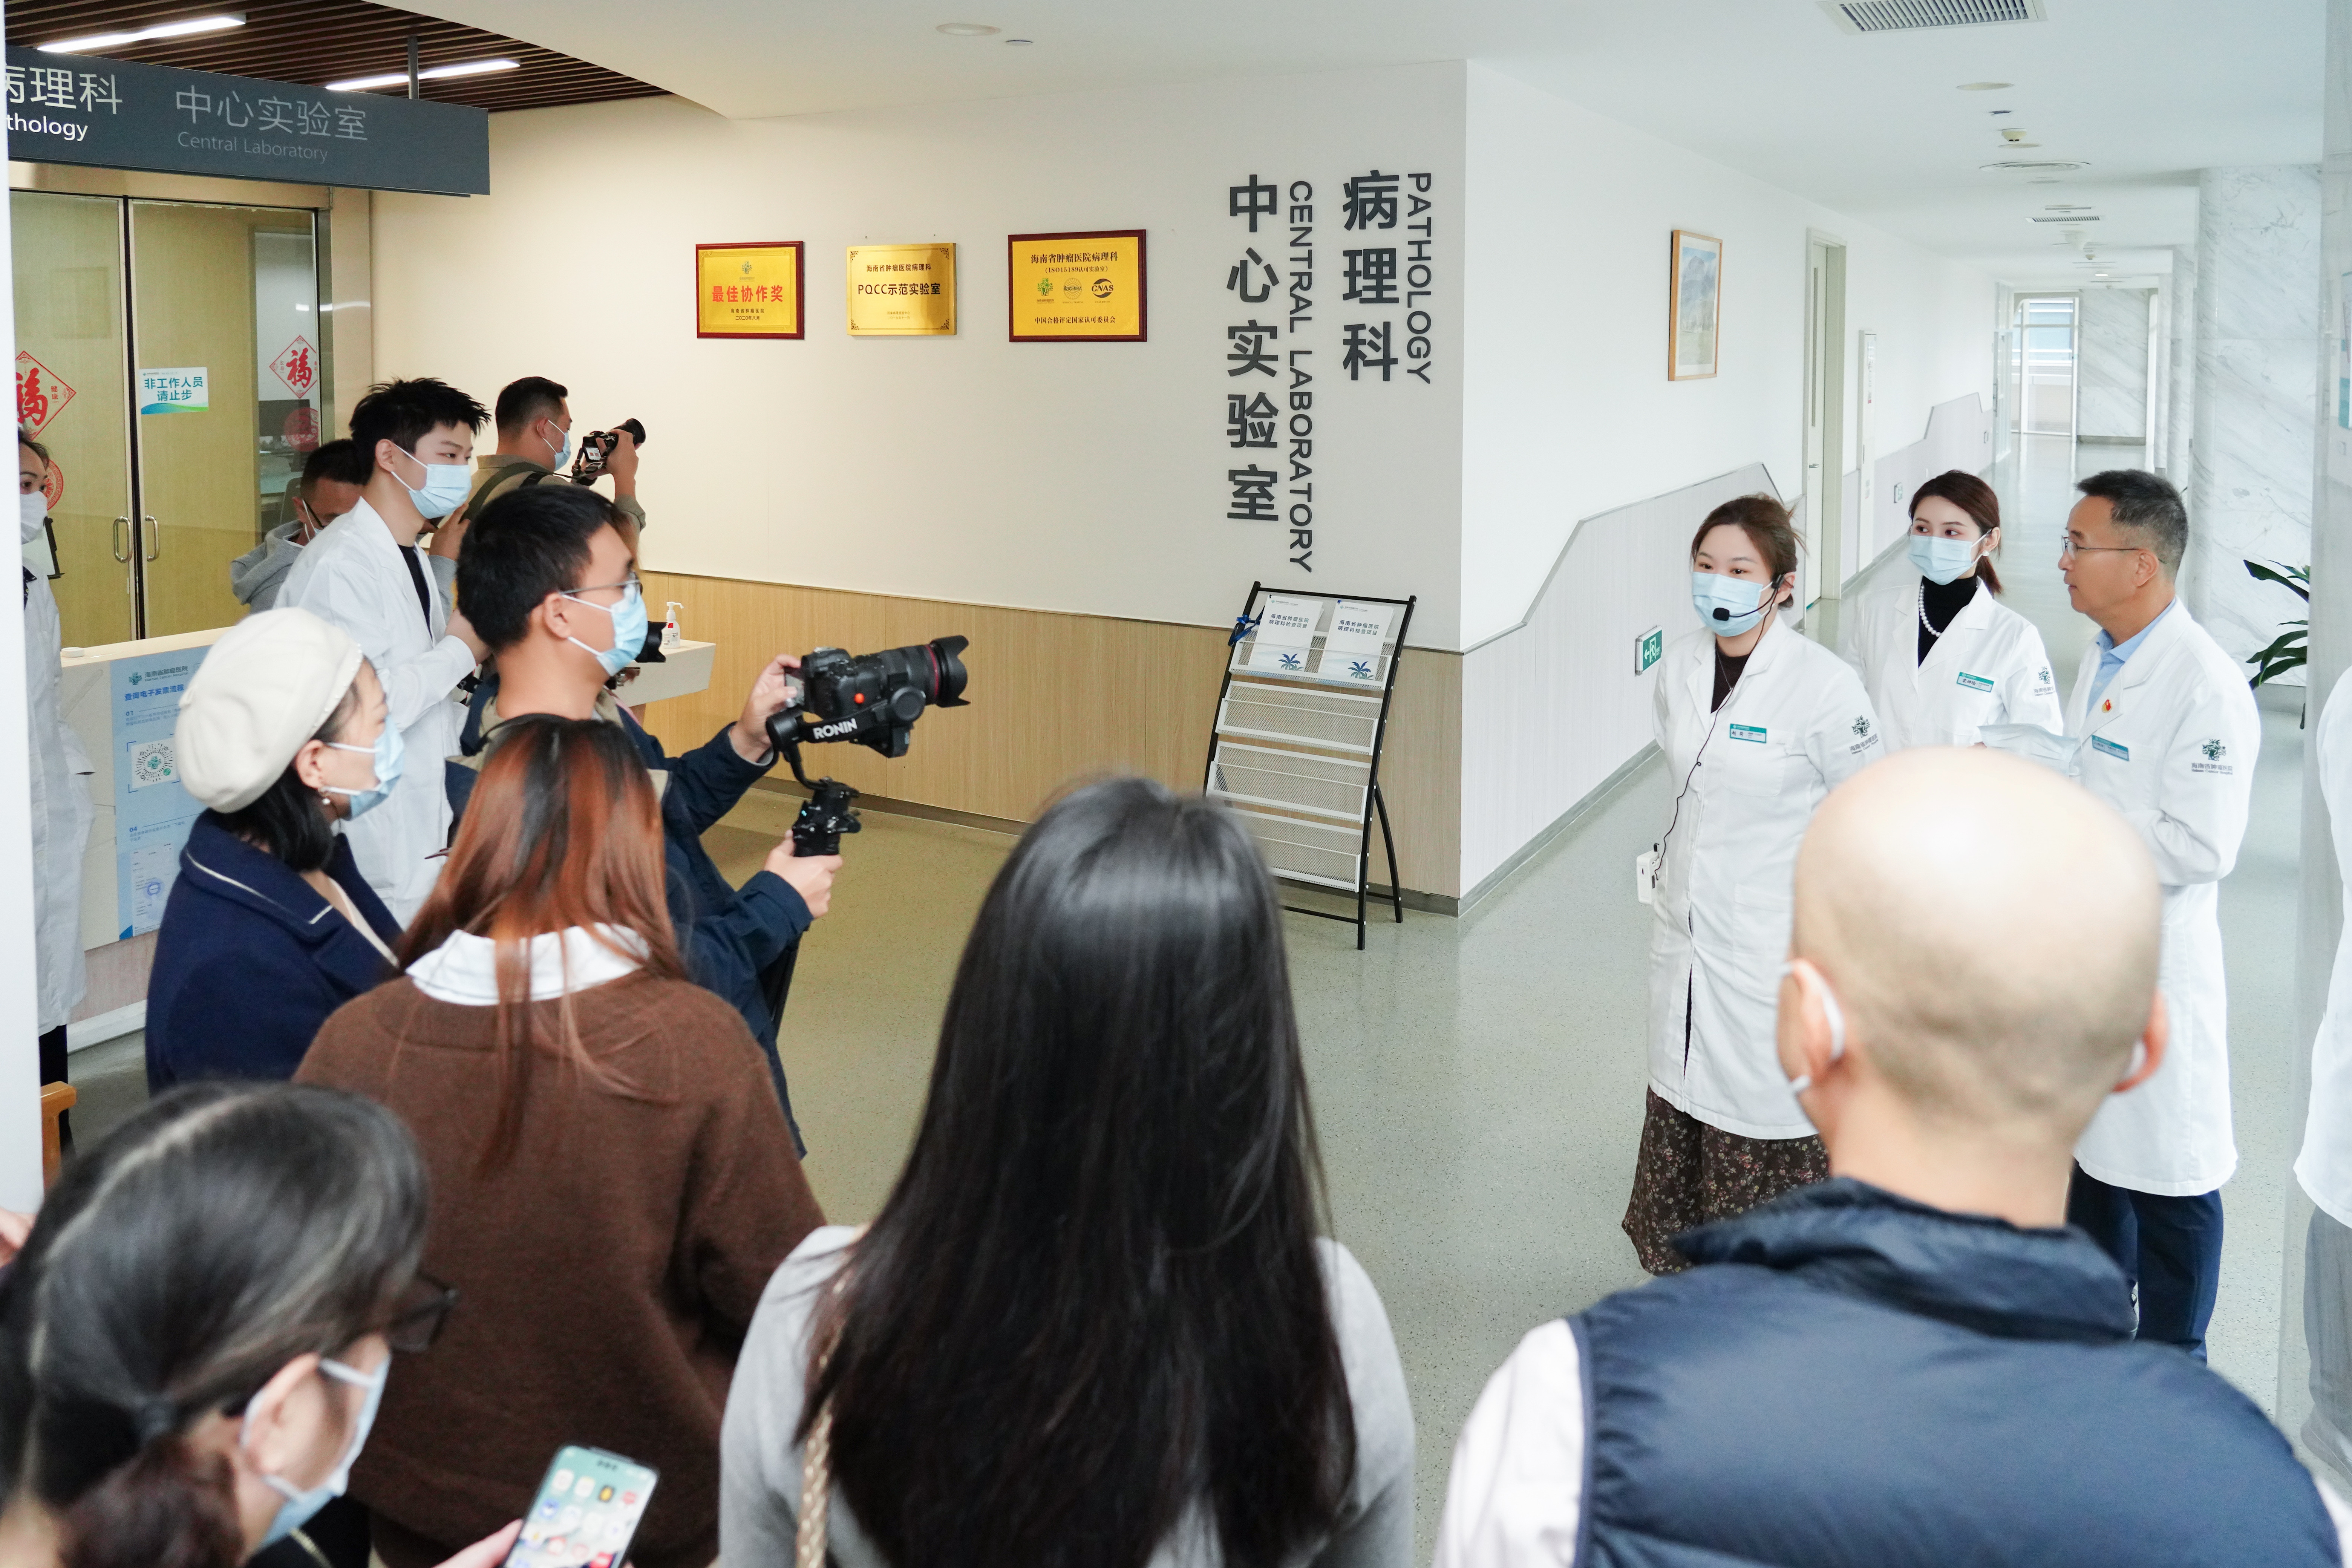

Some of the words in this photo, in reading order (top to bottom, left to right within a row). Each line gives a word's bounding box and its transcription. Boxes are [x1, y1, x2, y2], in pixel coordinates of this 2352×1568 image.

[176, 85, 368, 140] 中心实验室
[178, 131, 237, 152] Central
[244, 138, 328, 164] Laboratory
[1031, 251, 1118, 264] 海南省肿瘤医院病理科
[1289, 181, 1312, 333] CENTRAL
[866, 263, 932, 272] 海南省肿瘤医院病理科
[1342, 170, 1400, 381] 病理科
[1407, 173, 1432, 384] PATHOLOGY
[712, 285, 783, 302] 最佳协作奖
[858, 283, 941, 295] PQCC示范实验室
[1035, 316, 1116, 324] 中国合格评定国家认可委员会
[1227, 174, 1279, 521] 中心实验室
[286, 348, 312, 388] 福
[144, 377, 203, 389] 非工作人员
[157, 389, 192, 401] 请止步
[1289, 350, 1312, 573] LABORATORY
[1269, 619, 1308, 629] 病理科检查项目
[1271, 614, 1309, 623] 海南省肿瘤医院
[1339, 620, 1379, 629] 海南省肿瘤医院
[1338, 625, 1378, 635] 病理科检查项目
[813, 718, 858, 740] RONIN
